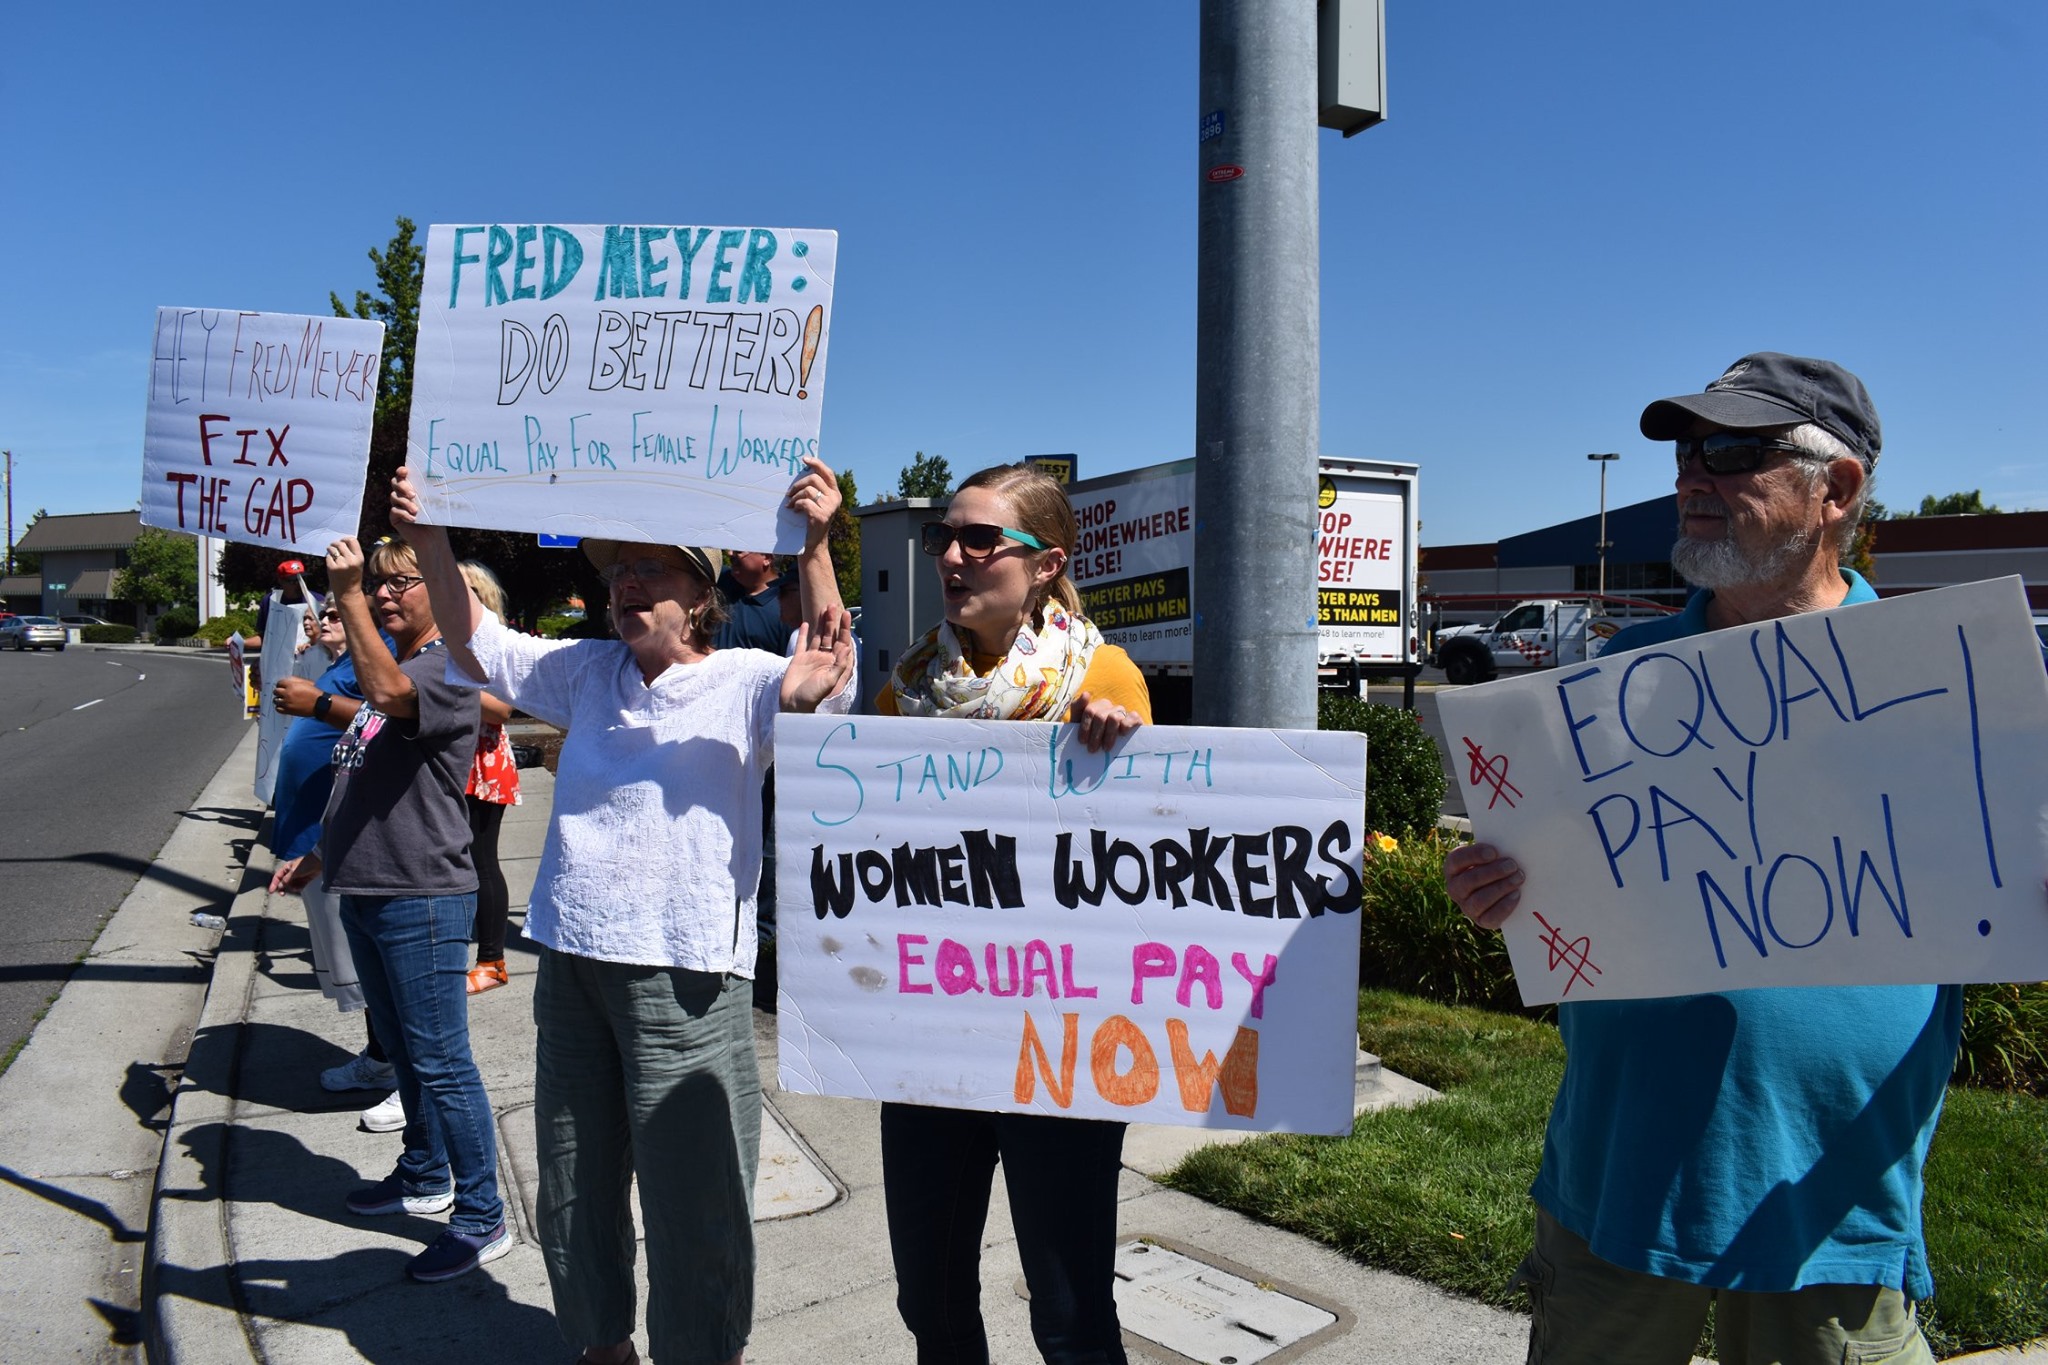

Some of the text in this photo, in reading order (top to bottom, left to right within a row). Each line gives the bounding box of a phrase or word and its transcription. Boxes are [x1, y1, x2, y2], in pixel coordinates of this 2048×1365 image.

[449, 223, 808, 309] FRED MEYER:
[152, 310, 377, 405] HEY FRED MEYER
[497, 304, 823, 405] DO BETTER!
[199, 414, 291, 468] FIX
[426, 404, 818, 480] EQUAL PAY FOR FEMALE WORKERS
[1036, 464, 1069, 474] EST
[166, 472, 314, 544] THE GAP
[1073, 507, 1191, 557] SOMEWHERE
[1074, 500, 1117, 530] SHOP
[1318, 512, 1352, 534] OP
[1073, 550, 1122, 581] ELSE!
[1318, 536, 1393, 560] WHERE
[1318, 560, 1355, 583] SE!
[1090, 584, 1131, 607] MEYER
[1134, 578, 1166, 599] PAYS
[1094, 597, 1187, 627] ESS THAN MEN
[1318, 592, 1380, 606] YER PAYS
[1318, 608, 1398, 623] SS THAN MEN
[1129, 632, 1138, 643] to
[1140, 629, 1161, 642] learn
[1165, 622, 1192, 638] more!
[1332, 630, 1340, 638] to
[1341, 629, 1361, 639] learn
[1363, 630, 1385, 639] more!
[1557, 617, 1949, 783] EQUAL
[811, 722, 1213, 827] STAND WITH
[1586, 751, 1763, 889] PAY
[810, 820, 1363, 920] WOMEN WORKERS
[1696, 793, 1912, 969] NOW
[897, 933, 1278, 1019] EQUAL PAY
[1014, 1011, 1259, 1119] NOW
